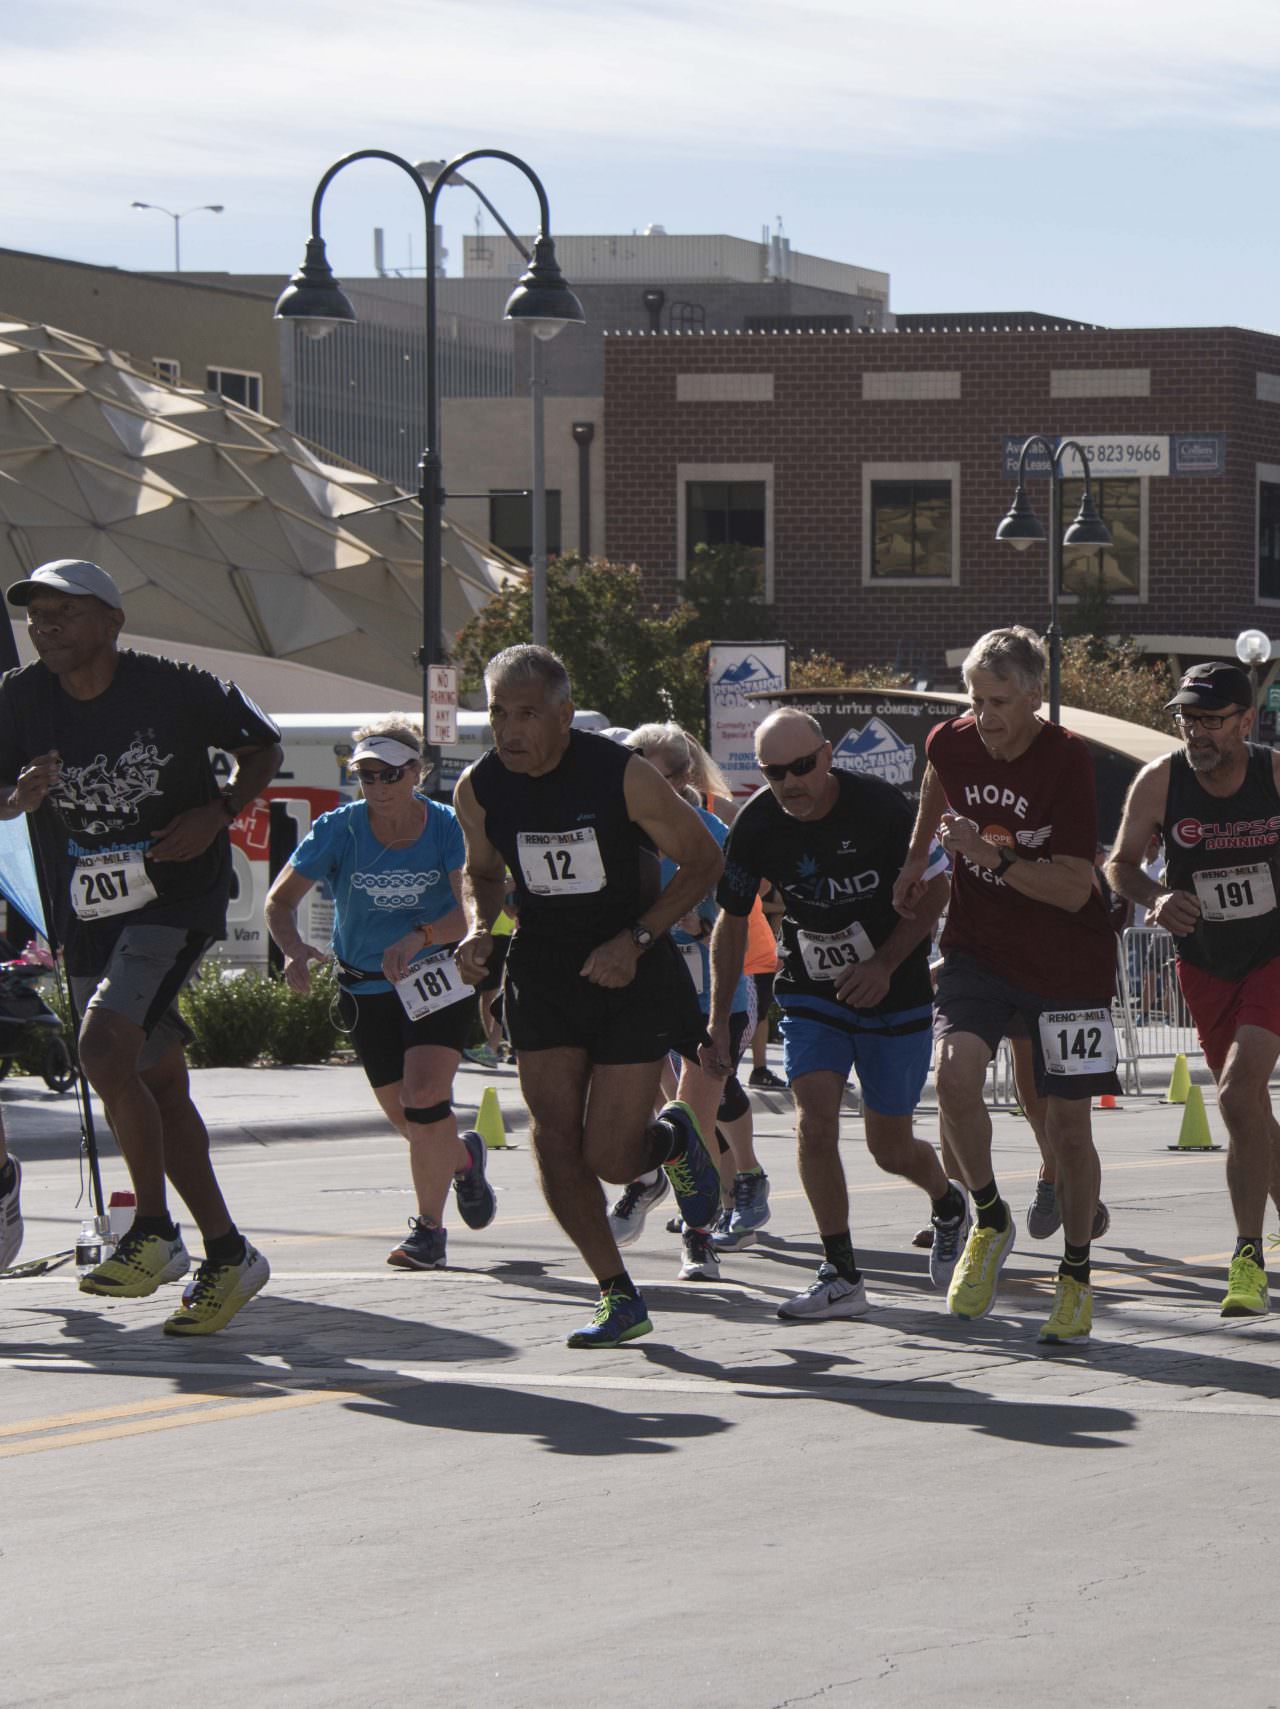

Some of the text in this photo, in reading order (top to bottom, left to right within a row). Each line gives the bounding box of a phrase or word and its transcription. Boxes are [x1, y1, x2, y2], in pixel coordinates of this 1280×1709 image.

[1098, 445, 1124, 462] 823
[1127, 444, 1161, 462] 9666
[1026, 458, 1054, 472] Lease
[437, 673, 449, 688] NO
[436, 710, 449, 721] ANY
[836, 705, 872, 714] LITTLE
[876, 703, 923, 714] COMEDY
[928, 704, 957, 714] CLUB
[435, 725, 451, 738] TIME
[964, 784, 1029, 819] HOPE
[525, 834, 550, 845] RENO
[1205, 832, 1280, 851] RUNNING
[543, 850, 577, 881] 12
[1201, 870, 1228, 879] RENO
[80, 870, 129, 906] 207
[1214, 880, 1255, 910] 191
[233, 928, 260, 941] Van
[813, 943, 860, 971] 203
[413, 967, 453, 1002] 181
[1048, 1012, 1076, 1024] RENO
[1057, 1027, 1103, 1061] 142
